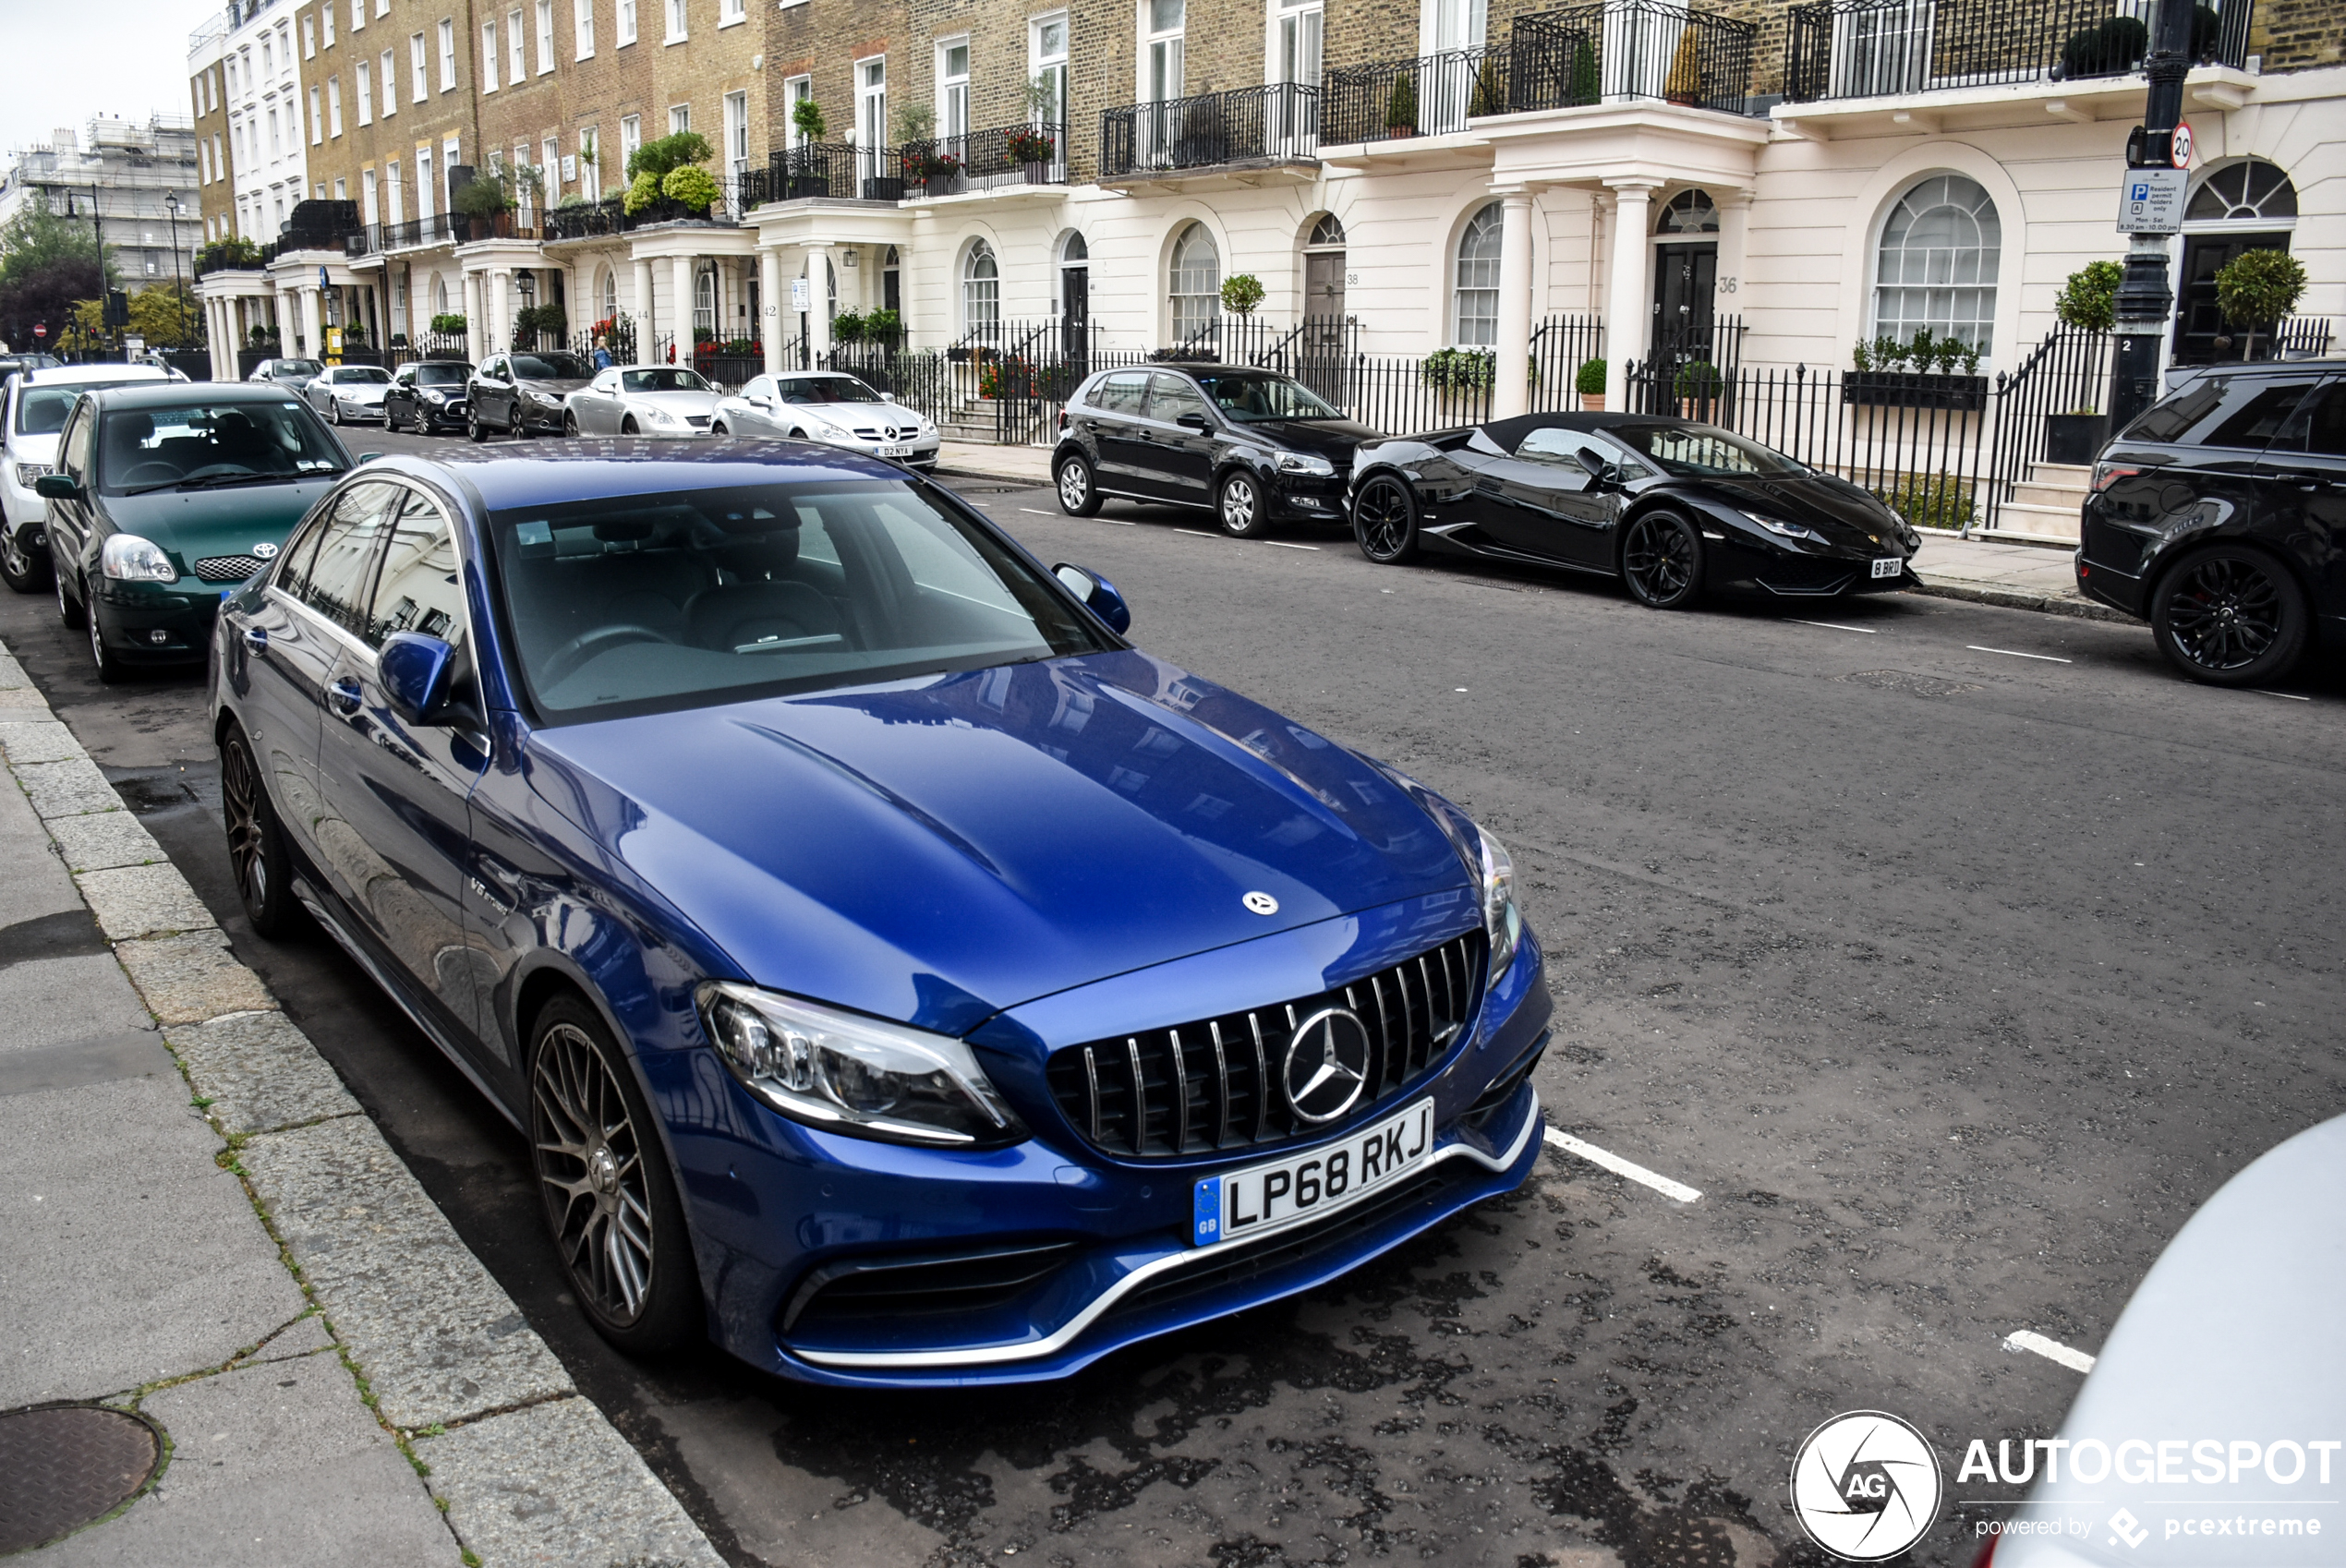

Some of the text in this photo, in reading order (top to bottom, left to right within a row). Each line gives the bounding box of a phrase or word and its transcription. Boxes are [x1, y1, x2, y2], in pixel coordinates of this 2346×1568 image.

[2175, 137, 2190, 157] 20
[2134, 186, 2146, 199] P
[1347, 273, 1358, 284] 38
[1719, 276, 1736, 294] 36
[2122, 340, 2131, 351] 2
[884, 447, 909, 456] D2 NYA
[1875, 561, 1900, 575] 8 BRD
[1230, 1109, 1427, 1229] LP68 RKJ
[1199, 1218, 1217, 1234] GB
